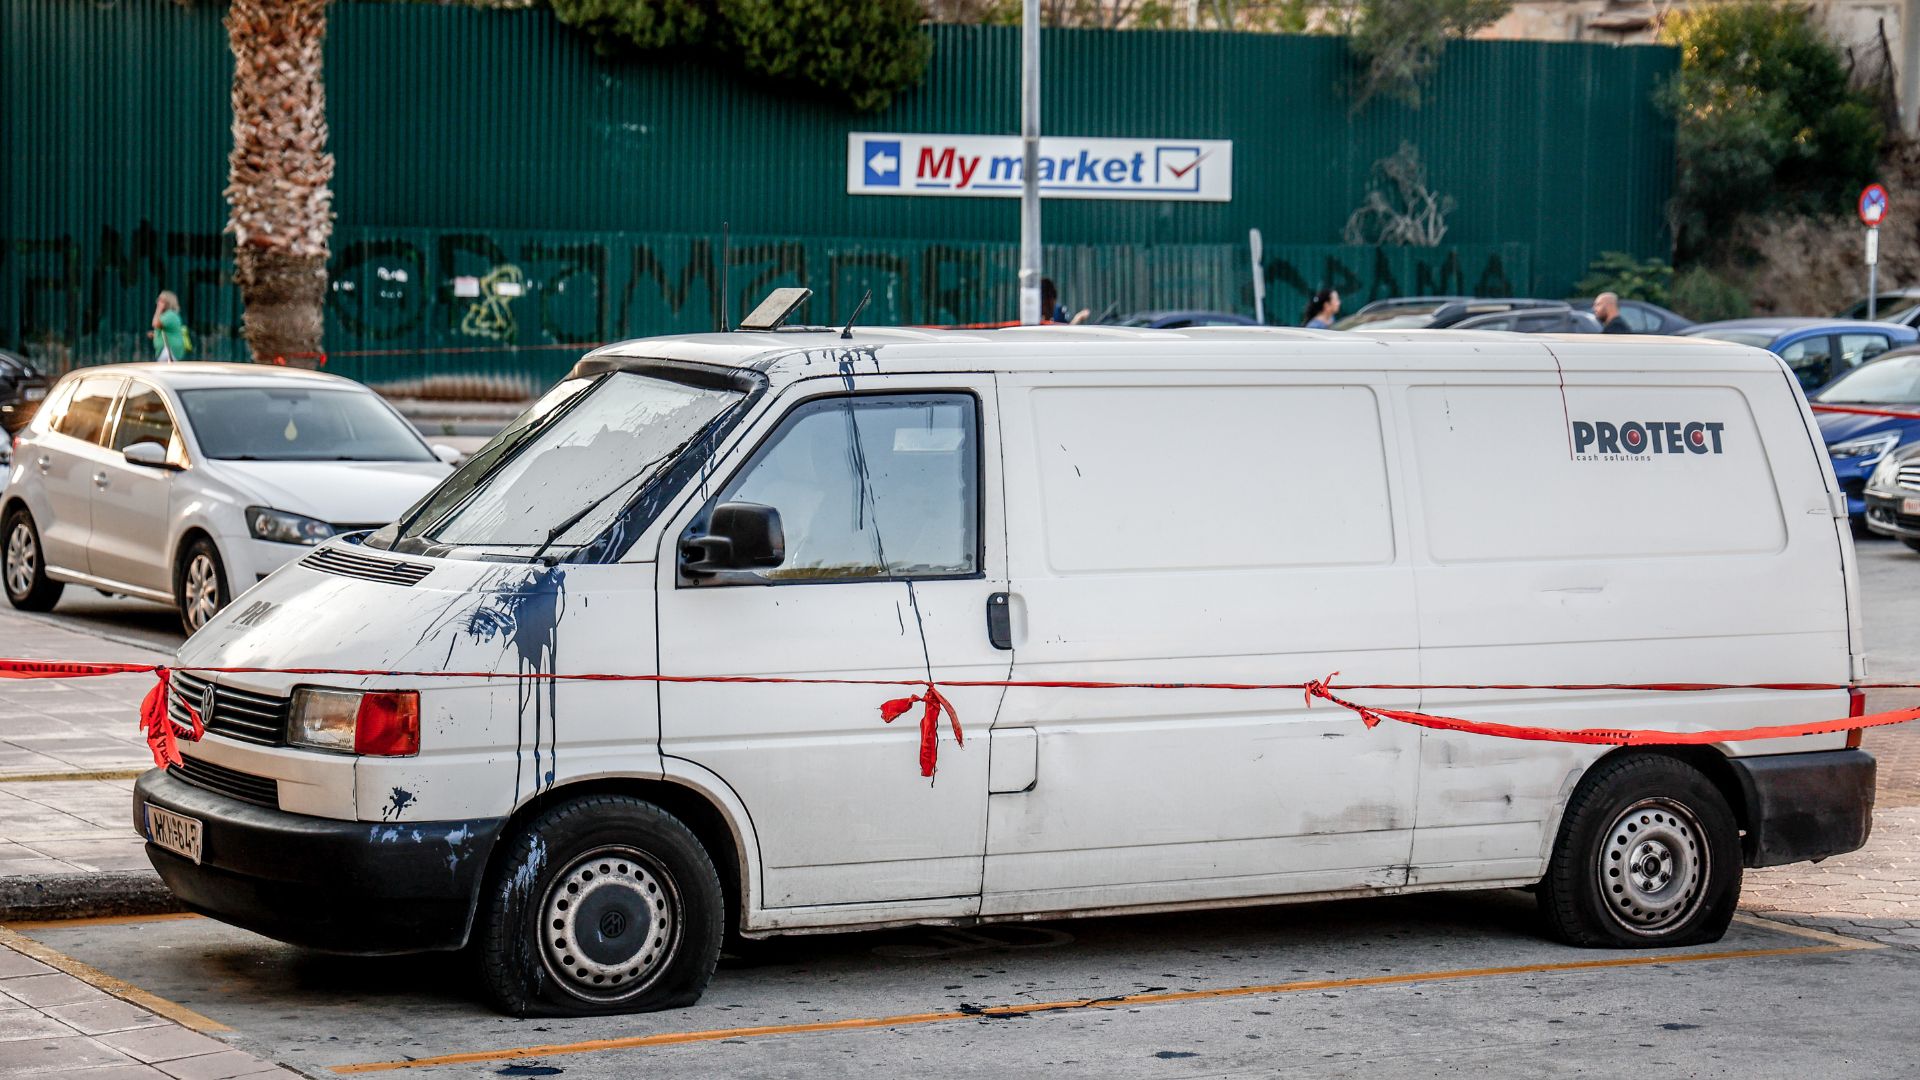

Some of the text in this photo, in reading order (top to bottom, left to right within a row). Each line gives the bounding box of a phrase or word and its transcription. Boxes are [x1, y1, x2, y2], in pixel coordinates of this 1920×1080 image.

[916, 147, 1144, 189] My market
[1572, 421, 1725, 455] PROTECT
[1604, 454, 1651, 462] solutions
